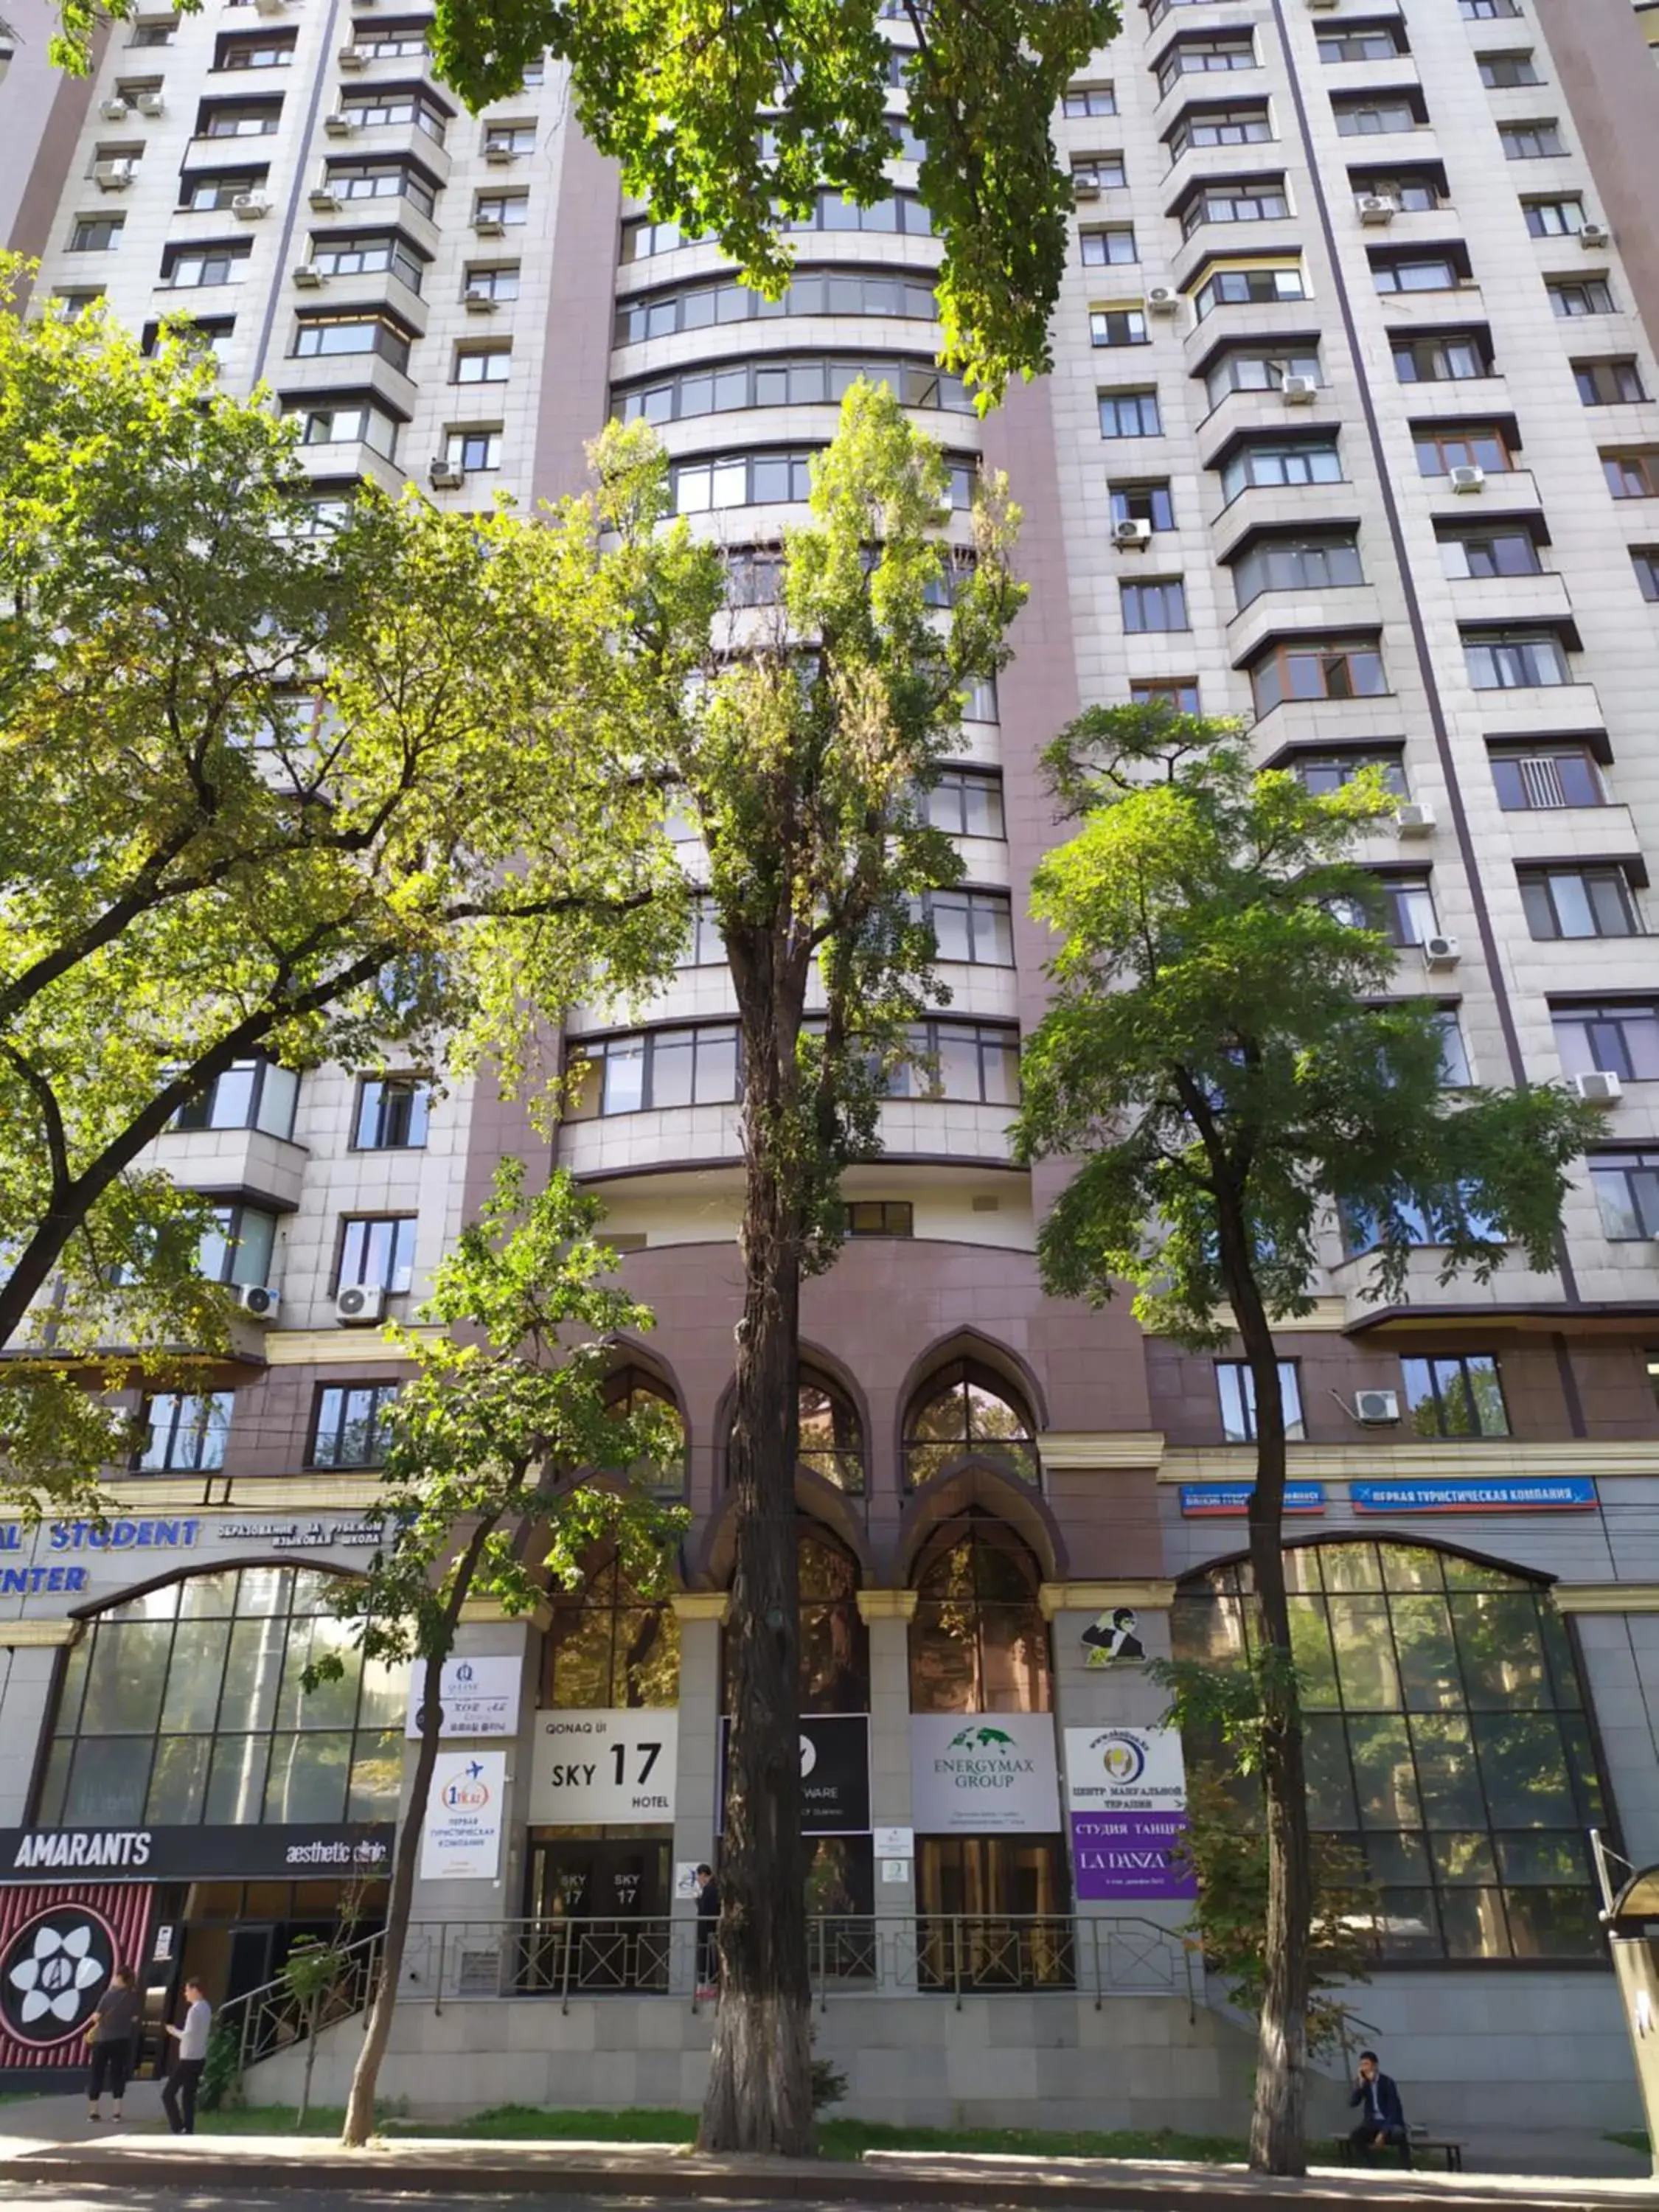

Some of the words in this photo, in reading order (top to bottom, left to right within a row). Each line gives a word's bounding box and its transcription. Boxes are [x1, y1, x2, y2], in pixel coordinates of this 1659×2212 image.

[1372, 1490, 1415, 1502] ПЕРВАЯ
[1416, 1488, 1508, 1502] ТУРИСТИЧЕСКАЯ
[1510, 1486, 1572, 1500] КОМПАНИЯ
[50, 1520, 200, 1549] STUDENT
[218, 1523, 294, 1537] ОБРАЗОВАНИЕ
[272, 1534, 332, 1546] ЯЗЫКОВАЯ
[341, 1534, 380, 1545] ШКОЛА
[0, 1566, 86, 1593] NTER
[546, 1723, 592, 1733] QONAQ
[552, 1764, 597, 1787] SKY
[610, 1742, 662, 1786] 17
[933, 1759, 1035, 1773] ENERGYMAX
[955, 1775, 1015, 1788] GROUP
[1073, 1786, 1107, 1797] ЦЕНТР
[1110, 1785, 1183, 1797] МАНУАЛЬНОЙ
[632, 1796, 669, 1808] HOTEL
[1104, 1799, 1152, 1809] ТЕРАПИИ
[1075, 1823, 1128, 1836] СТУДИЯ
[13, 1832, 152, 1868] AMARANTS
[285, 1840, 351, 1863] aesthetic
[1080, 1852, 1105, 1869] LA
[1109, 1851, 1166, 1869] DANZA
[560, 1874, 587, 1886] SKY
[613, 1874, 641, 1886] SKY
[564, 1890, 583, 1905] 17
[617, 1889, 636, 1904] 17
